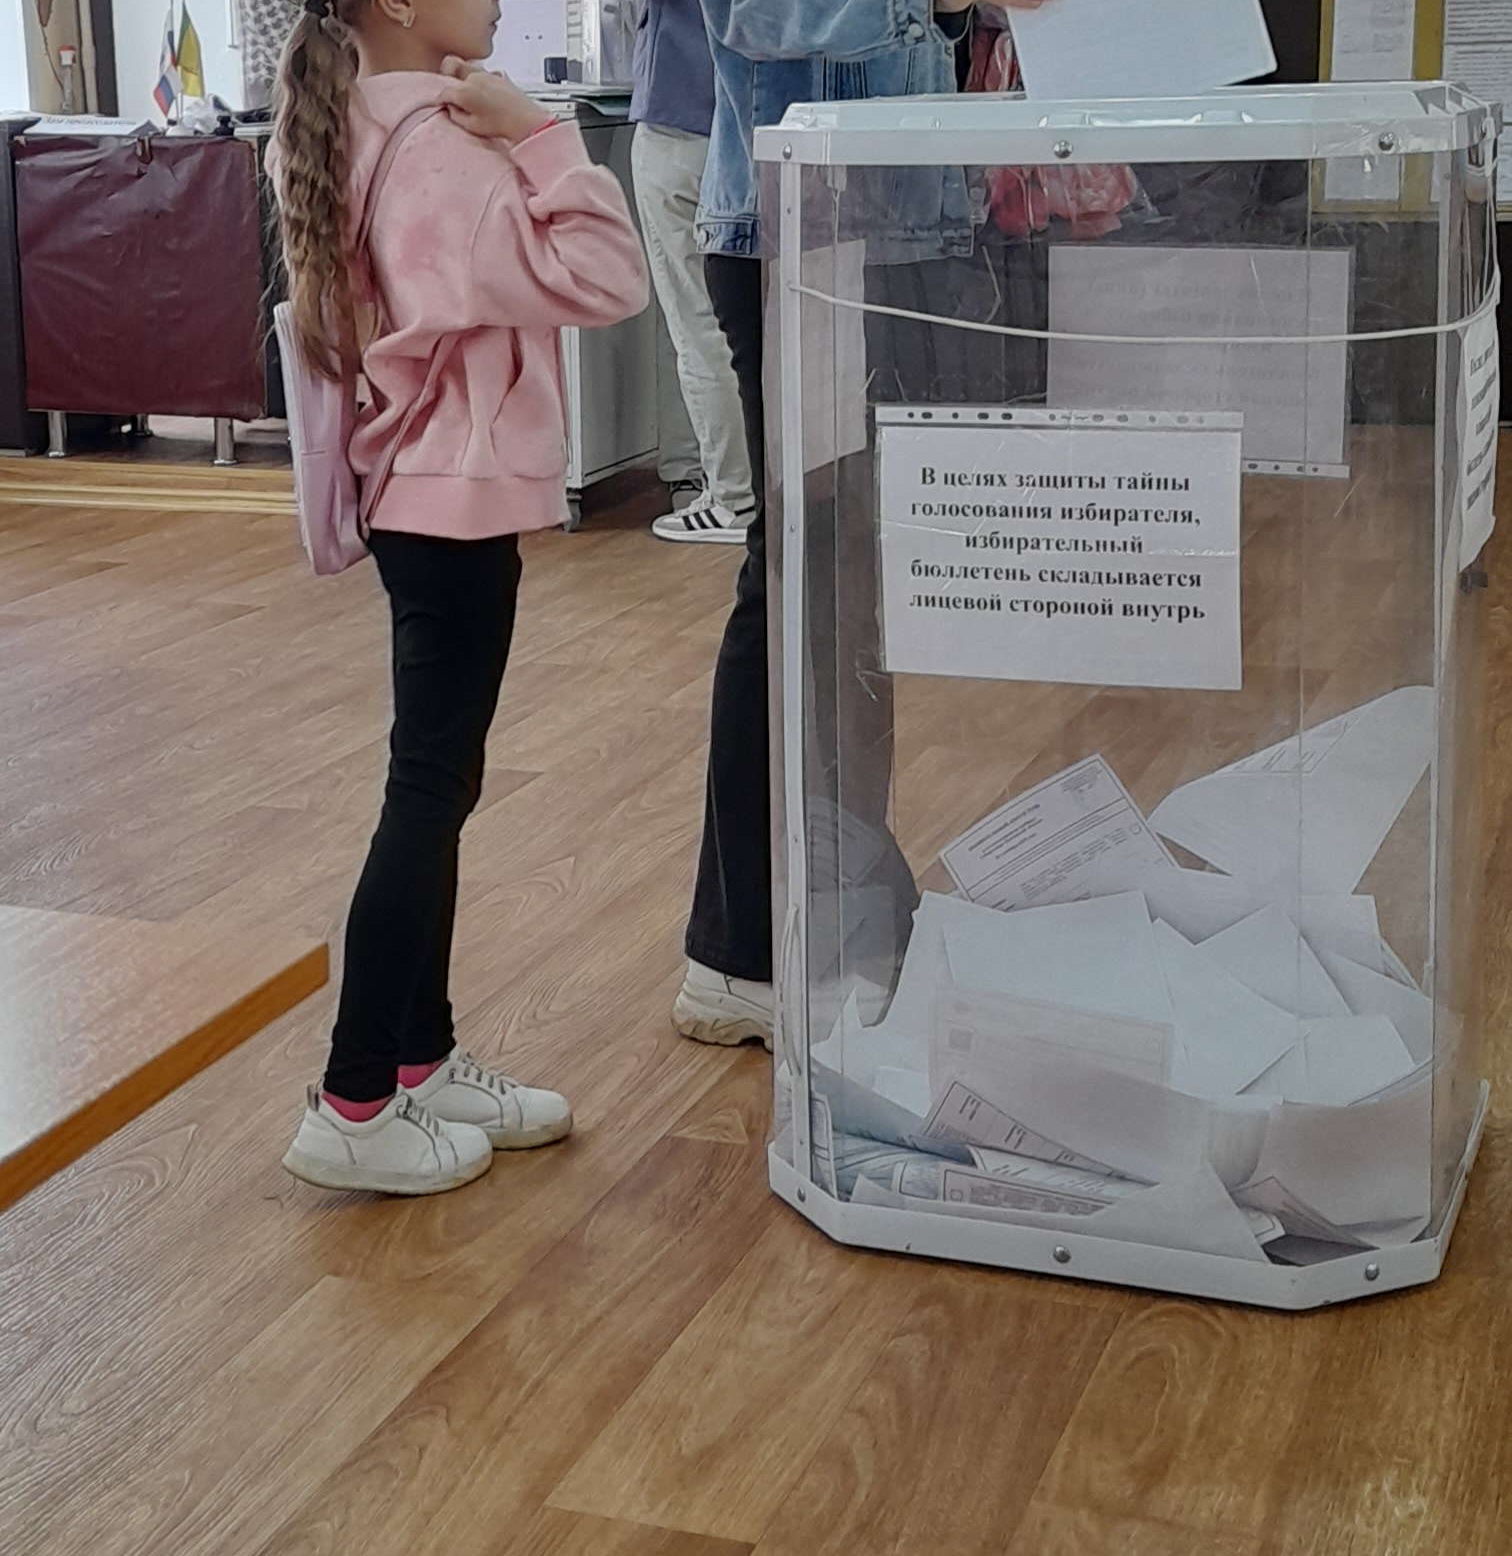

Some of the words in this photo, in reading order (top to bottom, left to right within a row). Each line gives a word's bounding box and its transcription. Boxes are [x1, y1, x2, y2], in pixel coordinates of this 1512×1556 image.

[920, 466, 937, 486] В
[943, 471, 1008, 489] целях
[1014, 473, 1107, 491] защиты
[1113, 471, 1190, 492] тайны
[910, 500, 1053, 521] голосования
[1061, 502, 1201, 527] избирателя,
[965, 531, 1143, 555] избирательный
[910, 558, 1031, 582] бюллетень
[1037, 567, 1202, 589] складывается
[909, 593, 1002, 613] лицевой
[1009, 598, 1113, 619] стороной
[1122, 603, 1205, 624] внутрь
